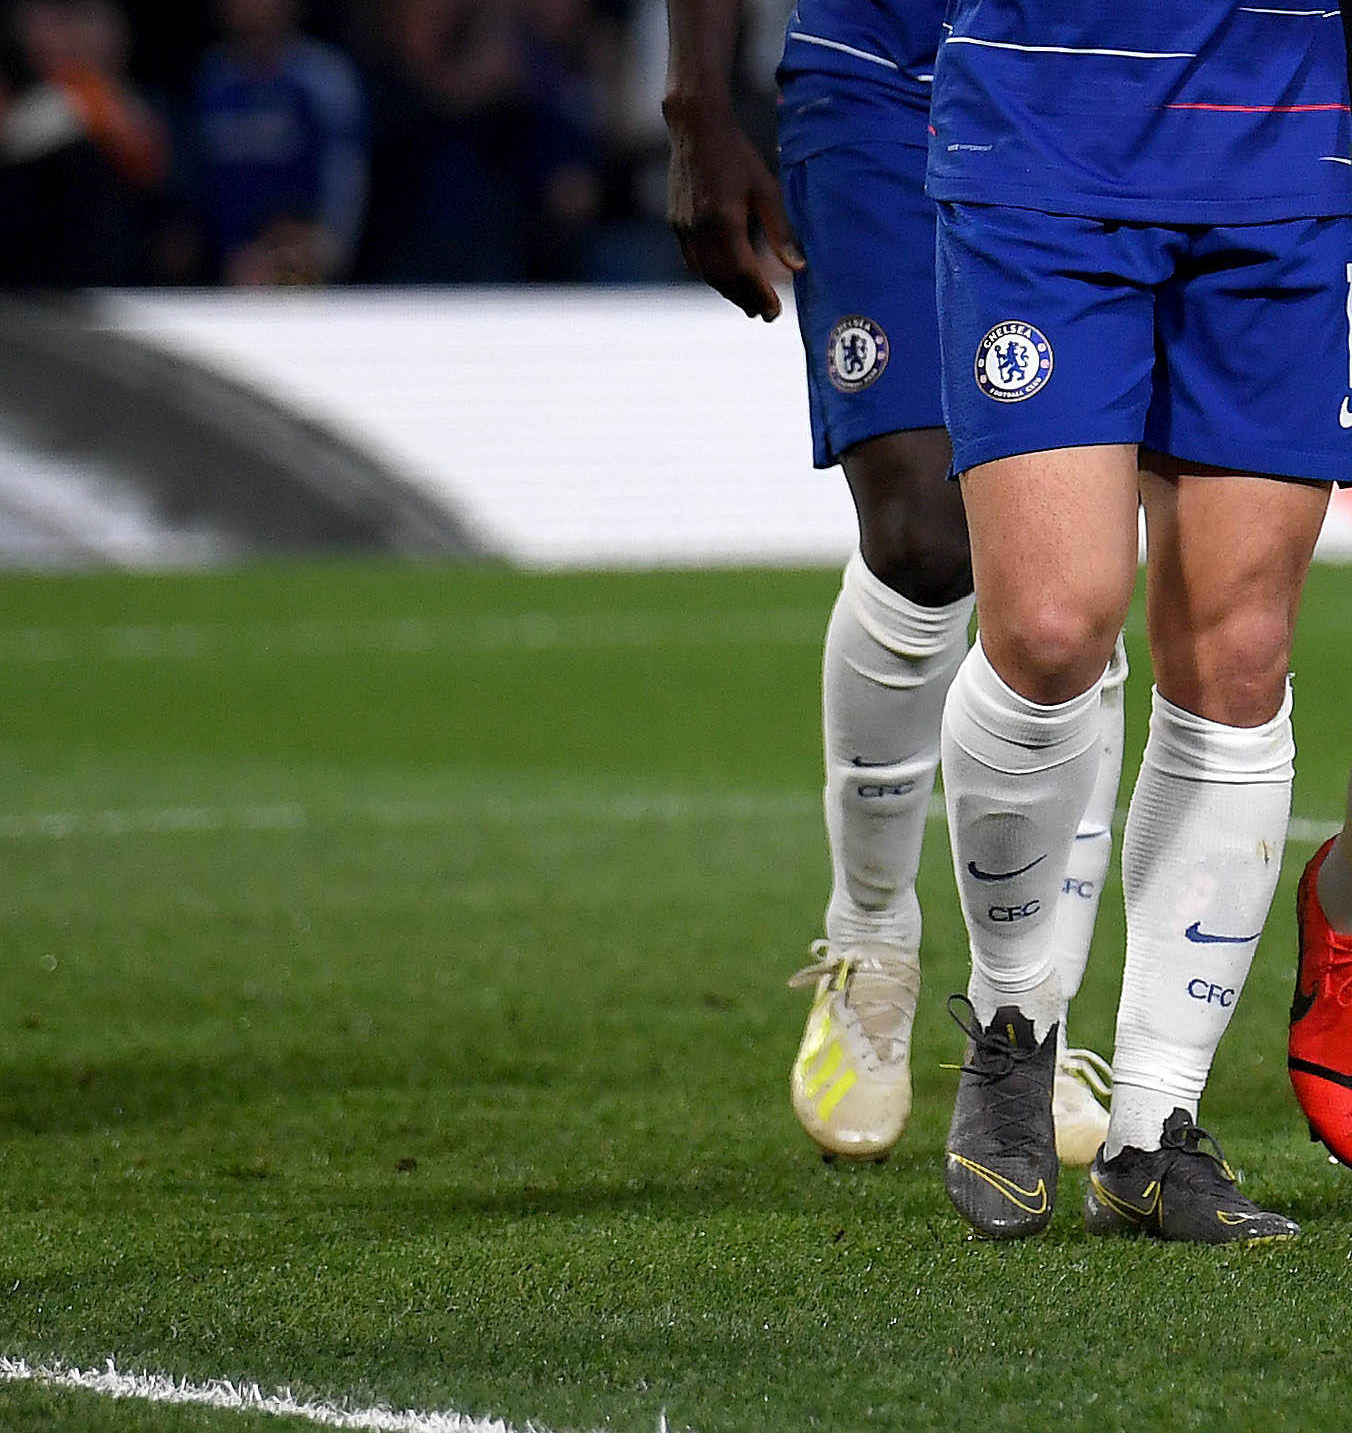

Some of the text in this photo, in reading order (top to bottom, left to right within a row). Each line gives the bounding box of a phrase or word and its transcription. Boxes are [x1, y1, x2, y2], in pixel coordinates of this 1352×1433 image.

[984, 325, 1032, 348] CHELSEA
[858, 780, 915, 798] CFC
[1062, 877, 1094, 898] FC
[988, 899, 1040, 922] CFC
[1188, 978, 1235, 1007] CFC
